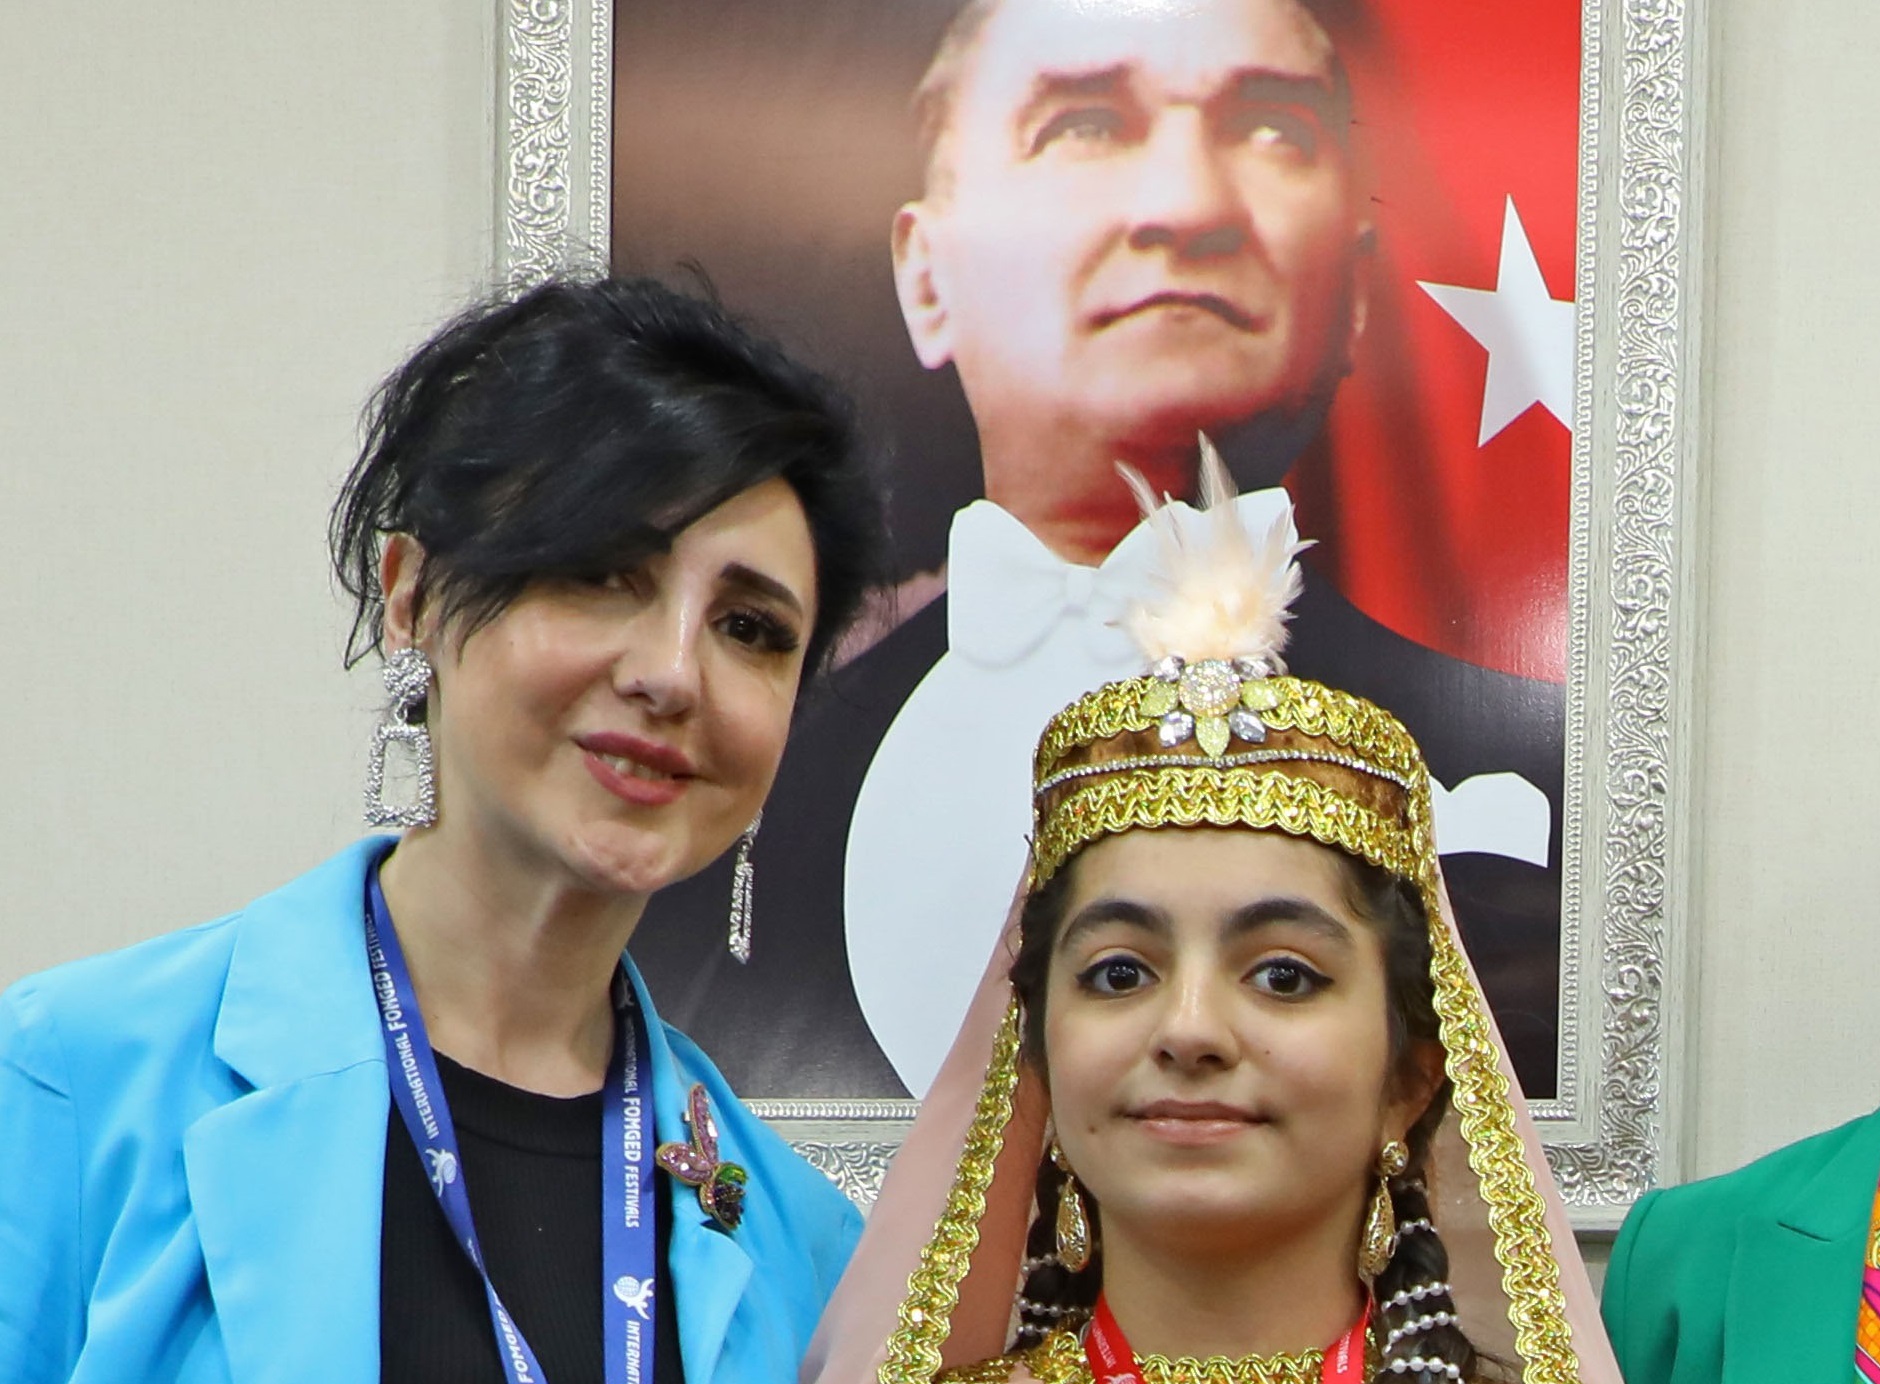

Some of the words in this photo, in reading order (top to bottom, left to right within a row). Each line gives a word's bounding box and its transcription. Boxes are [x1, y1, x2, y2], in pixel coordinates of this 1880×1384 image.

[375, 971, 407, 1031] FOMGED
[391, 1032, 439, 1140] INTERNATIONAL
[622, 1097, 641, 1162] FOMGED
[624, 1165, 639, 1229] FESTIVALS
